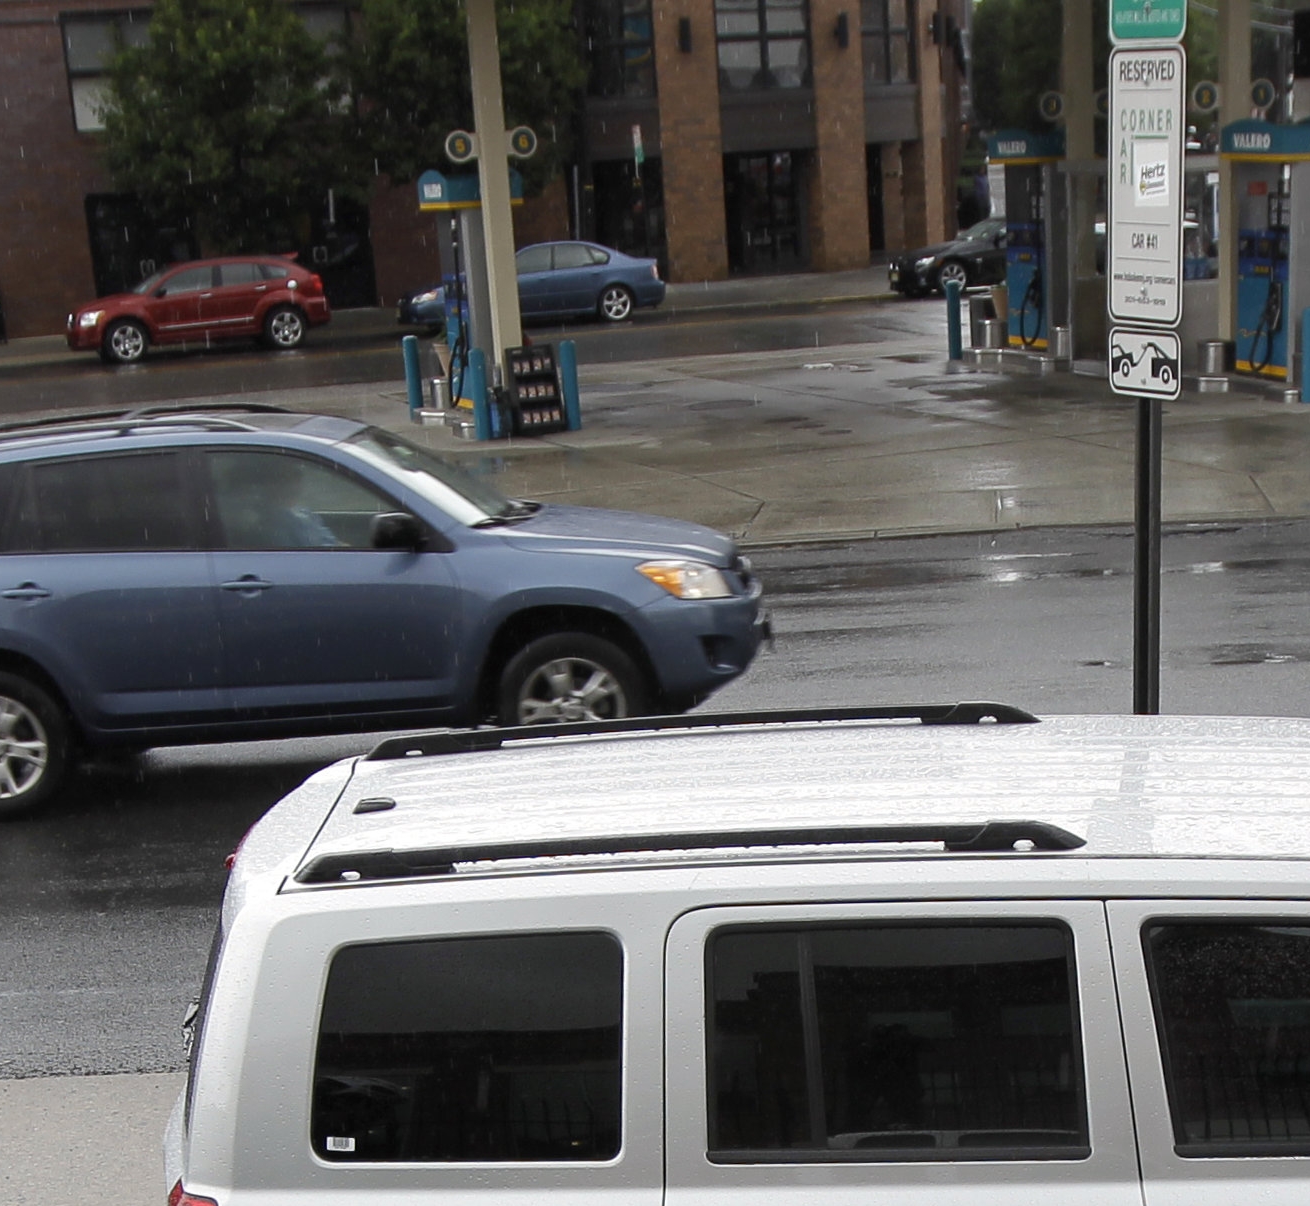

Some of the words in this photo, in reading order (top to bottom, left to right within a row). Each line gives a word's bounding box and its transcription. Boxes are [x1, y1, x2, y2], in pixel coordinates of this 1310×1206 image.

[1119, 59, 1175, 81] RESERVED
[1120, 109, 1173, 131] CORNER
[997, 140, 1027, 154] VALERO
[1233, 133, 1271, 149] VALERO
[1140, 163, 1166, 180] Hertz
[1132, 232, 1145, 249] CAR
